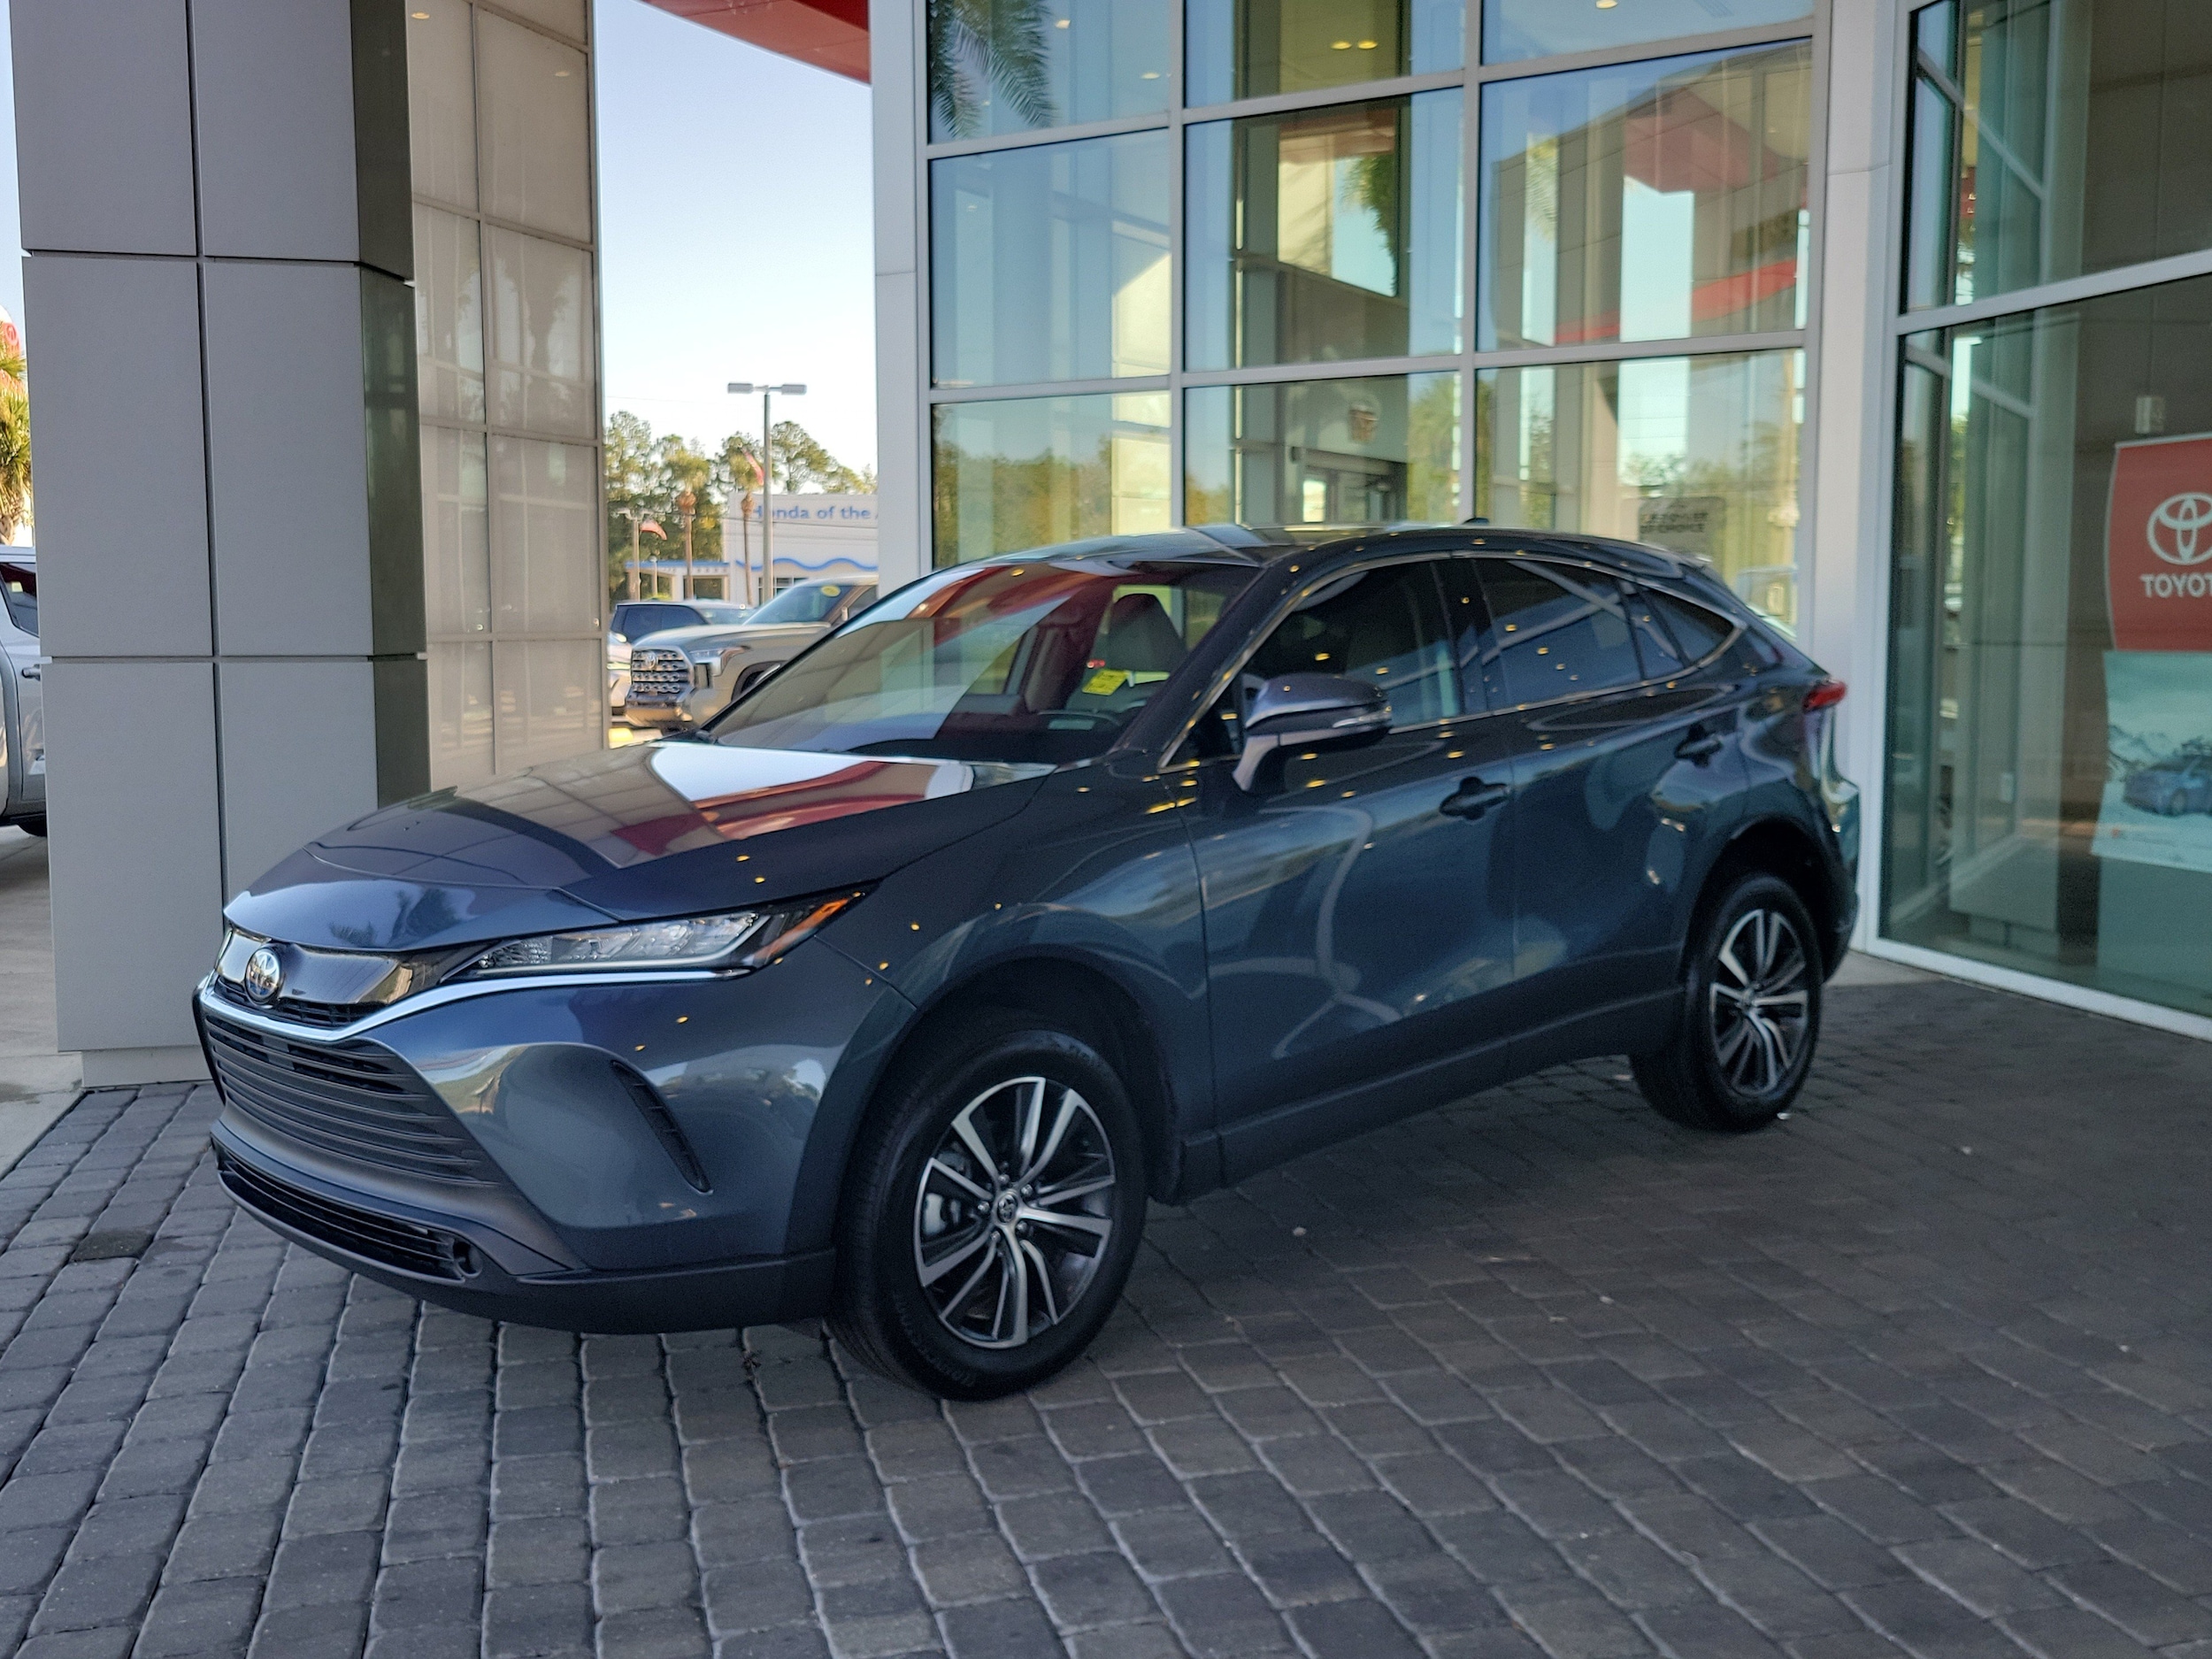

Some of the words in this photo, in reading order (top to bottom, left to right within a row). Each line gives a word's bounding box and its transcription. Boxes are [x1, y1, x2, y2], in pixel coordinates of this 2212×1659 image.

[752, 505, 810, 519] Hnda
[817, 506, 834, 519] of
[841, 506, 871, 519] the
